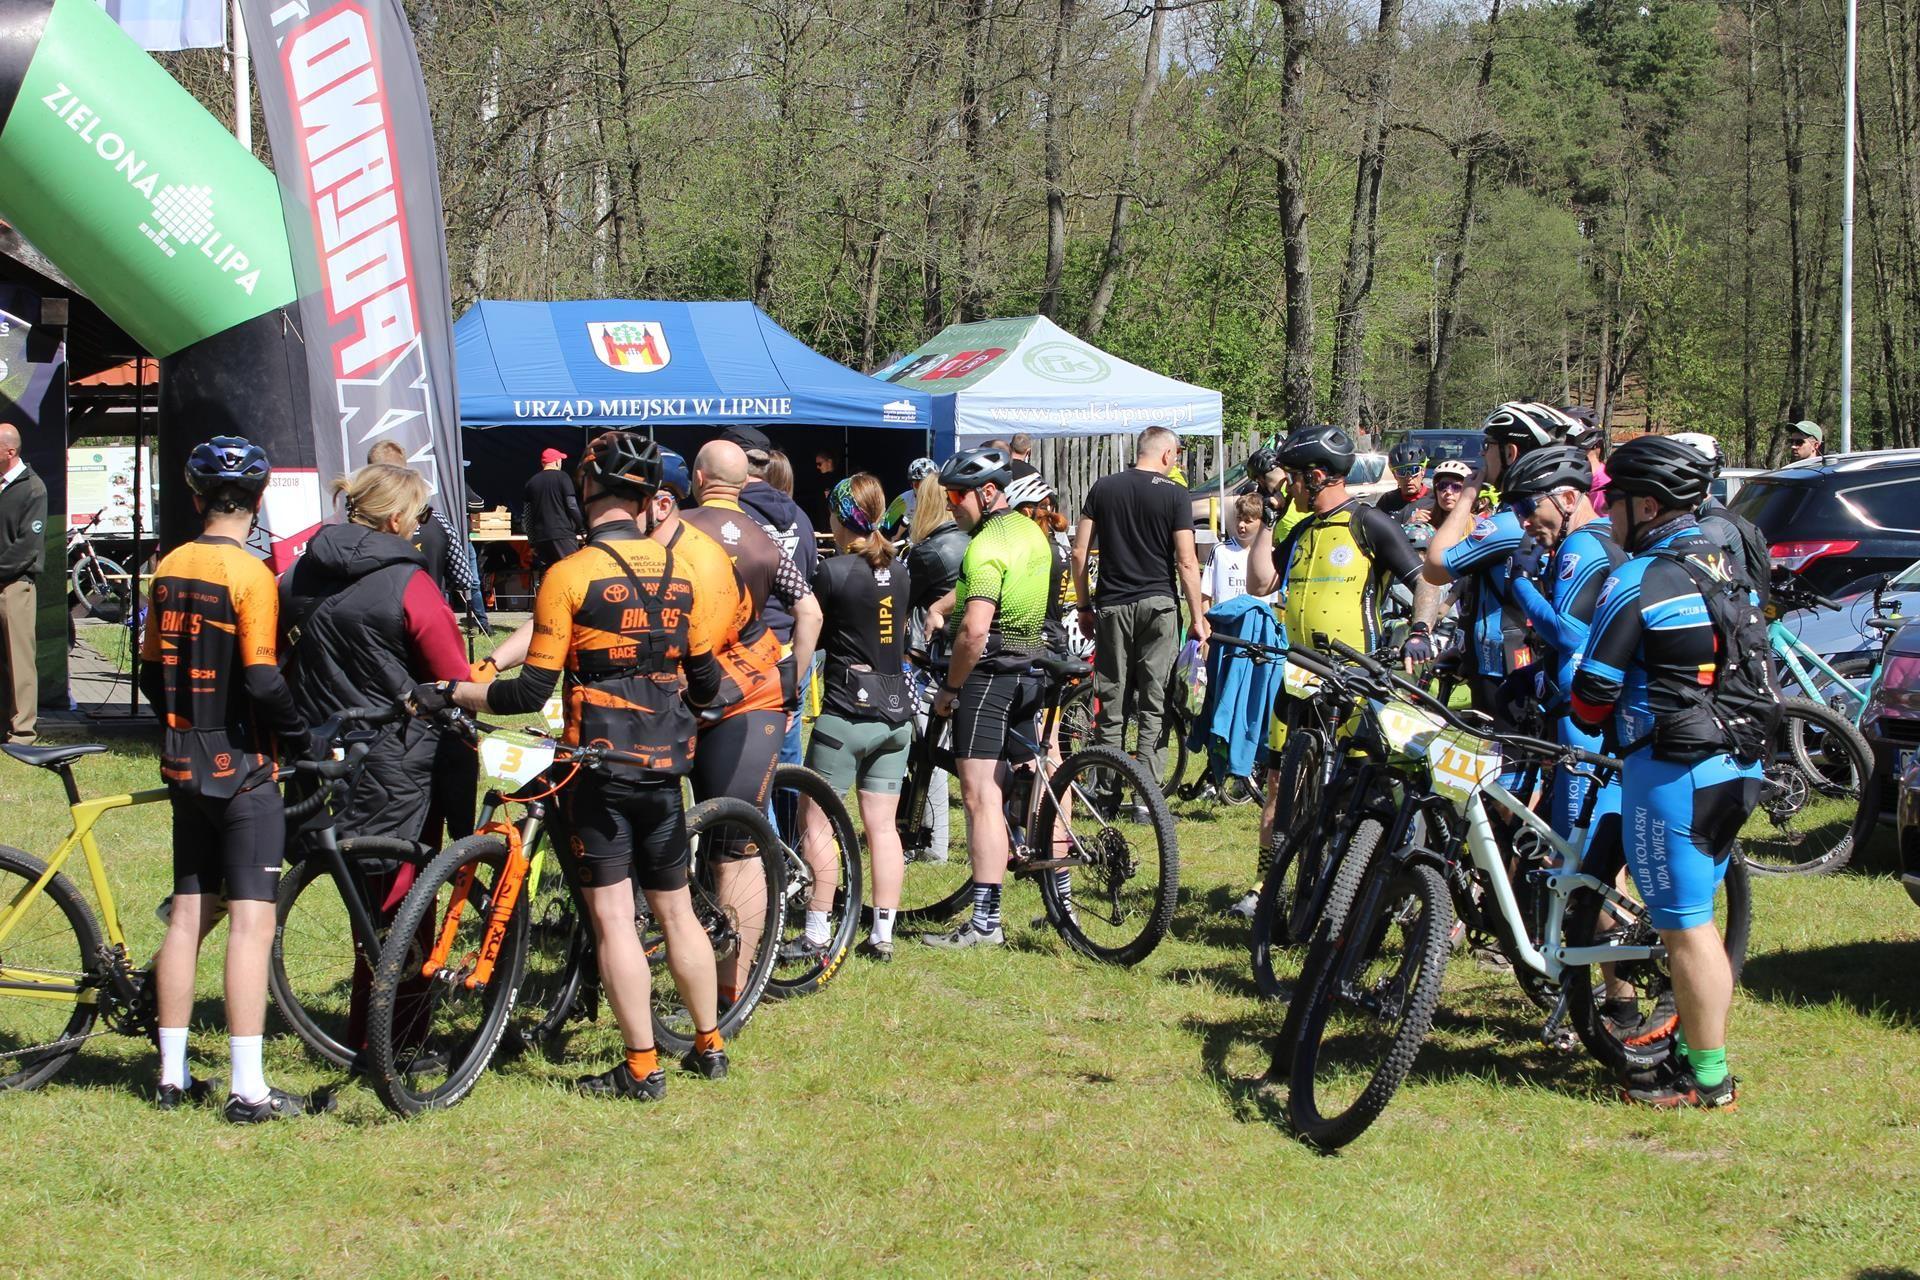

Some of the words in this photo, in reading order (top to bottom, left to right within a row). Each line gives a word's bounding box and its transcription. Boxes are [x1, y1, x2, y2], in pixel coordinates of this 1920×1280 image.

[42, 82, 162, 199] ZIELONA
[200, 232, 262, 296] LIPA
[514, 399, 594, 421] URZĄD
[600, 399, 686, 420] MIEJSKI
[692, 399, 715, 416] W
[719, 397, 792, 416] LIPNIE
[990, 401, 1194, 427] www.puklipno.pl
[621, 608, 681, 629] BIKRS
[880, 596, 892, 634] LIPA
[609, 646, 637, 660] RACE
[499, 746, 524, 773] 3
[1635, 806, 1648, 865] KOLARSKI
[1650, 819, 1666, 862] ŚWIECIE
[1834, 835, 1853, 855] SWISS
[1639, 868, 1656, 897] KLUB
[1657, 864, 1671, 890] WDA
[816, 946, 848, 985] MAXXIS
